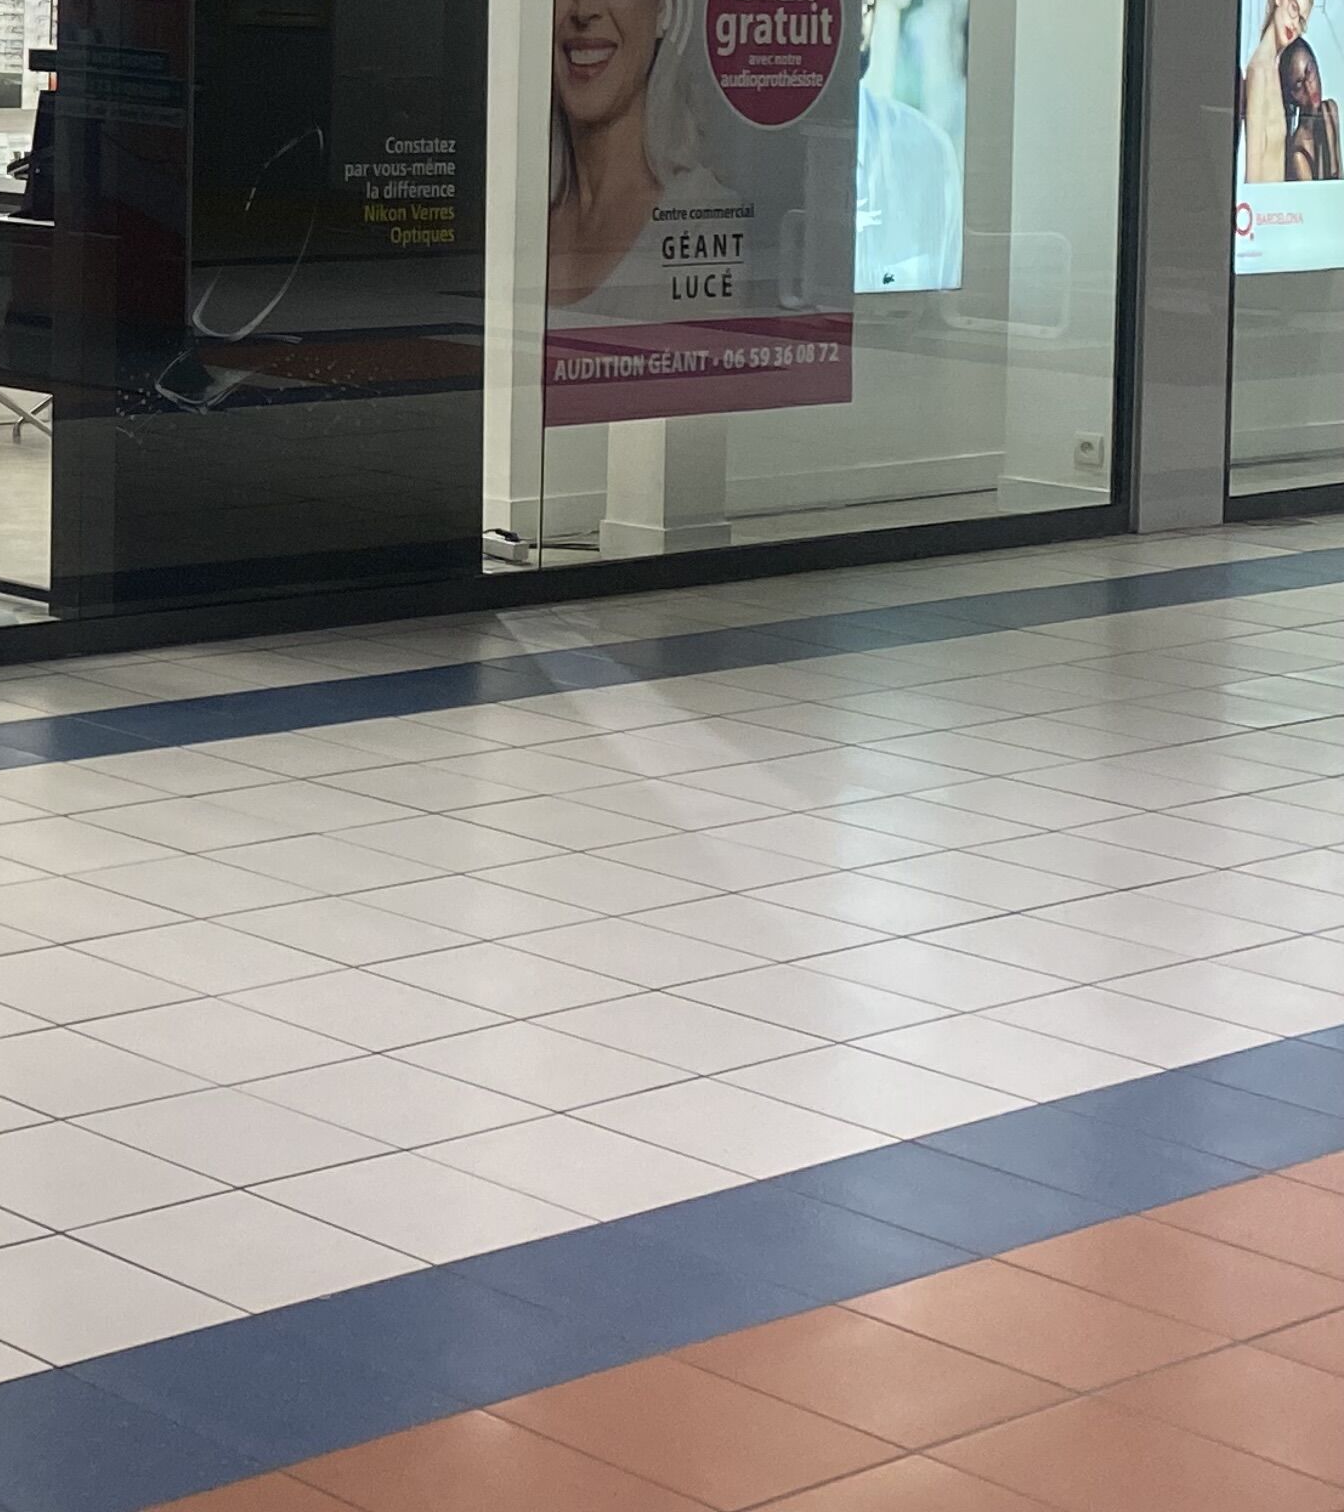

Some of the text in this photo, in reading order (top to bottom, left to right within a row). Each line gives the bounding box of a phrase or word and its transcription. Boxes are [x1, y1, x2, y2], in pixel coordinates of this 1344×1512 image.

[715, 2, 833, 56] gratuit
[748, 54, 773, 66] avec
[720, 69, 824, 92] audioprothésiste
[385, 136, 456, 154] Constatez
[344, 157, 456, 182] par vous-même
[366, 180, 456, 199] la différence
[364, 203, 455, 222] Nikon Verres
[652, 203, 755, 222] Centre commercial
[390, 225, 455, 247] Optiques
[662, 230, 744, 260] GÉANT
[671, 268, 733, 300] LUCÉ
[553, 353, 645, 381] AUDITION
[648, 348, 710, 376] GÉANT
[723, 348, 745, 370] 06
[749, 347, 771, 368] 59
[774, 345, 793, 366] 36
[795, 344, 815, 364] 08
[819, 342, 840, 363] 72
